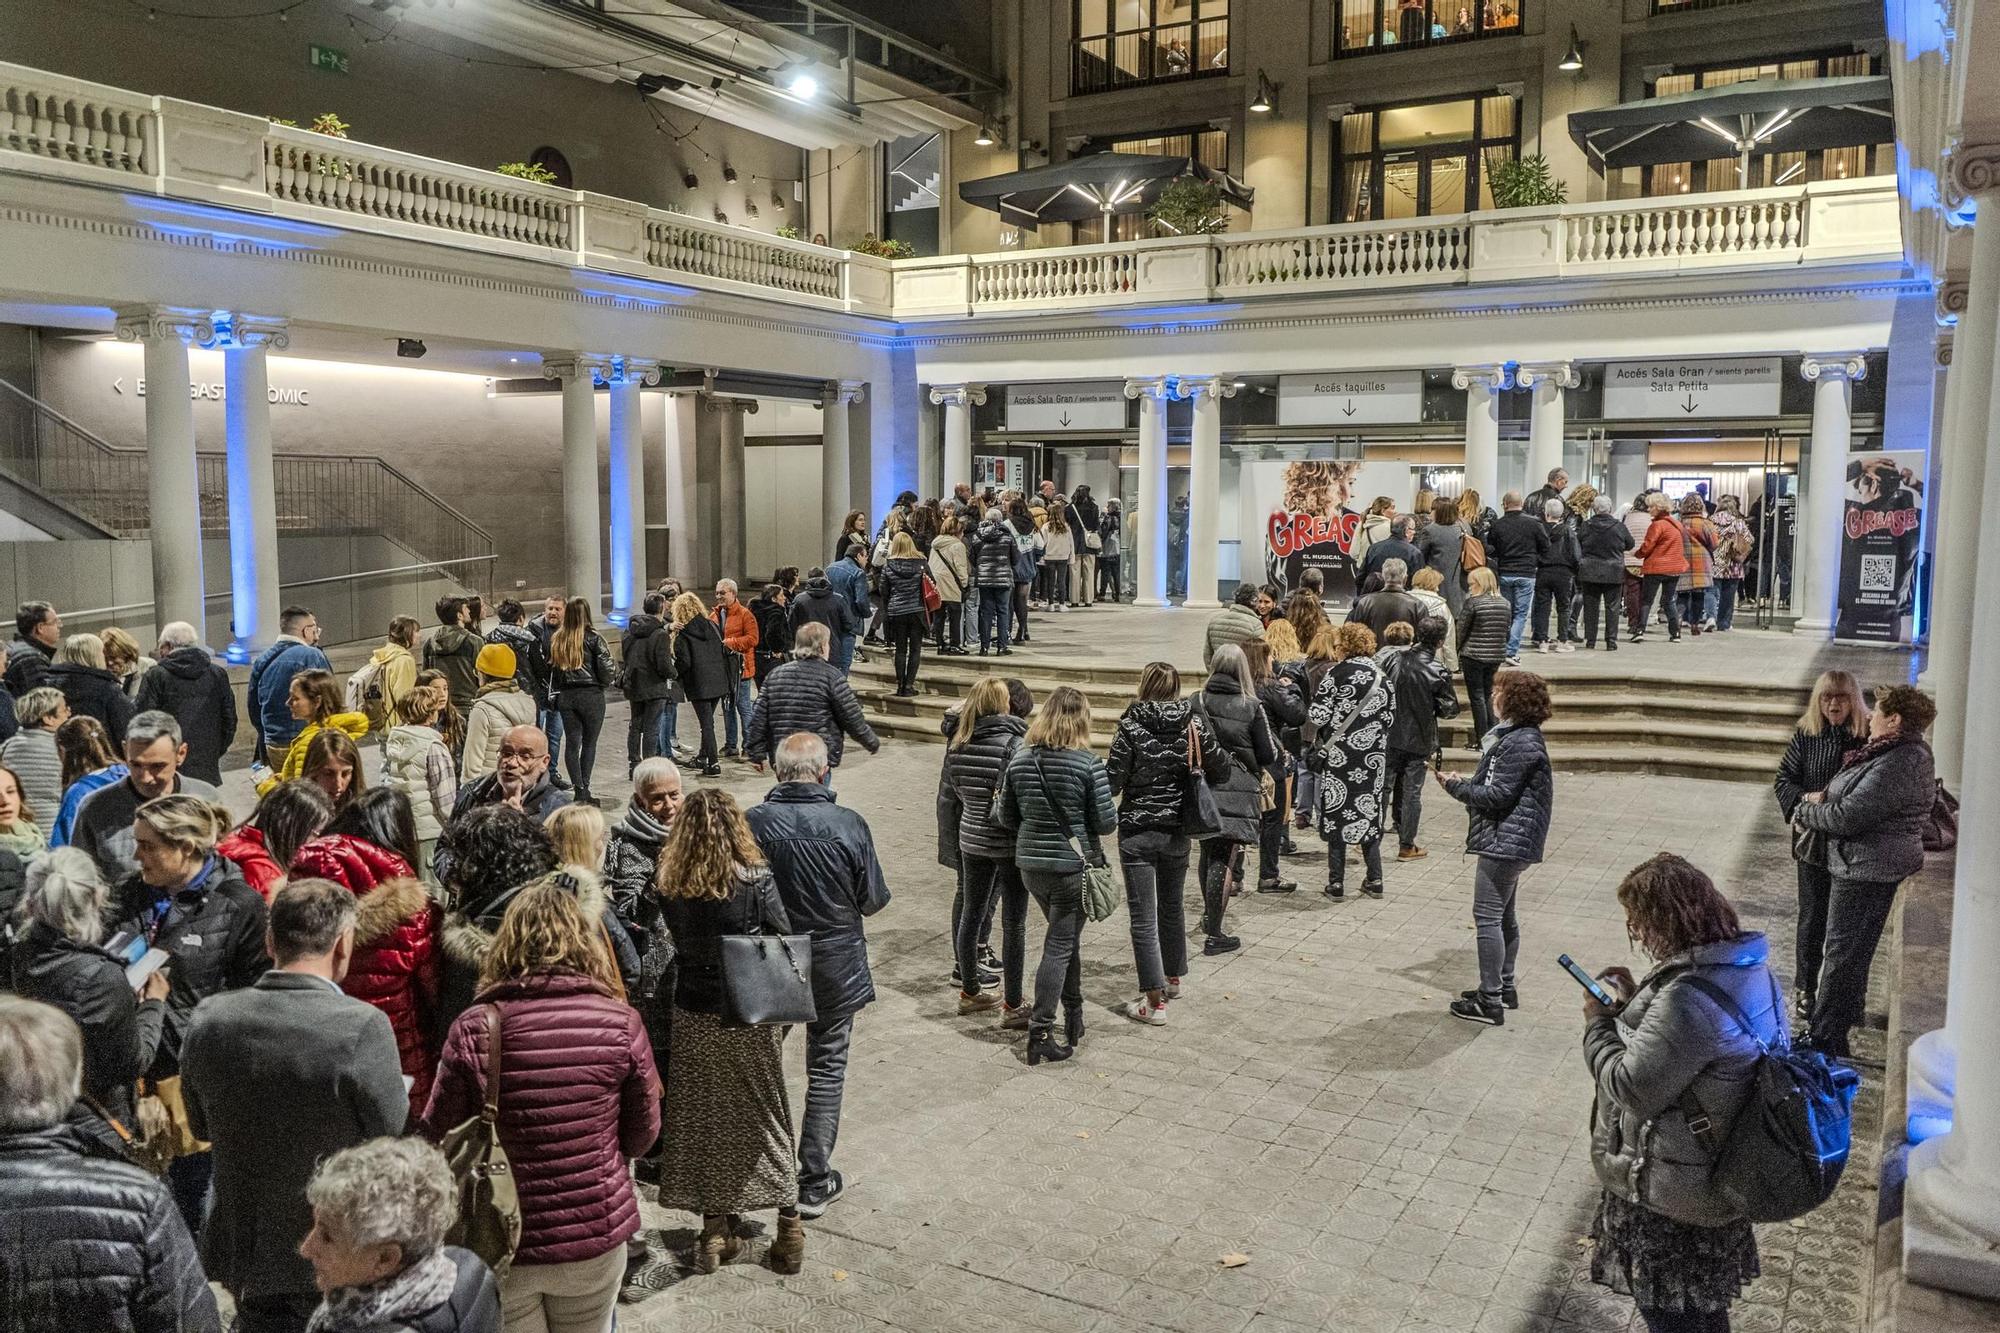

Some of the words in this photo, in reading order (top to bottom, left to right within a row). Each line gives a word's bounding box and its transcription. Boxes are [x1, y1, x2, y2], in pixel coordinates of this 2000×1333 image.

[1617, 367, 1647, 379] Accés
[1652, 367, 1675, 378] Sala
[1679, 366, 1704, 377] Gran
[1314, 382, 1341, 393] Accés
[1345, 381, 1386, 393] taquilles
[1651, 382, 1674, 392] Sala
[1678, 380, 1708, 392] Petita
[1014, 394, 1035, 405] Accés
[1037, 394, 1054, 404] Sala
[1056, 393, 1073, 404] Gran
[1846, 508, 1919, 539] GREASE
[1268, 510, 1360, 557] GREAS
